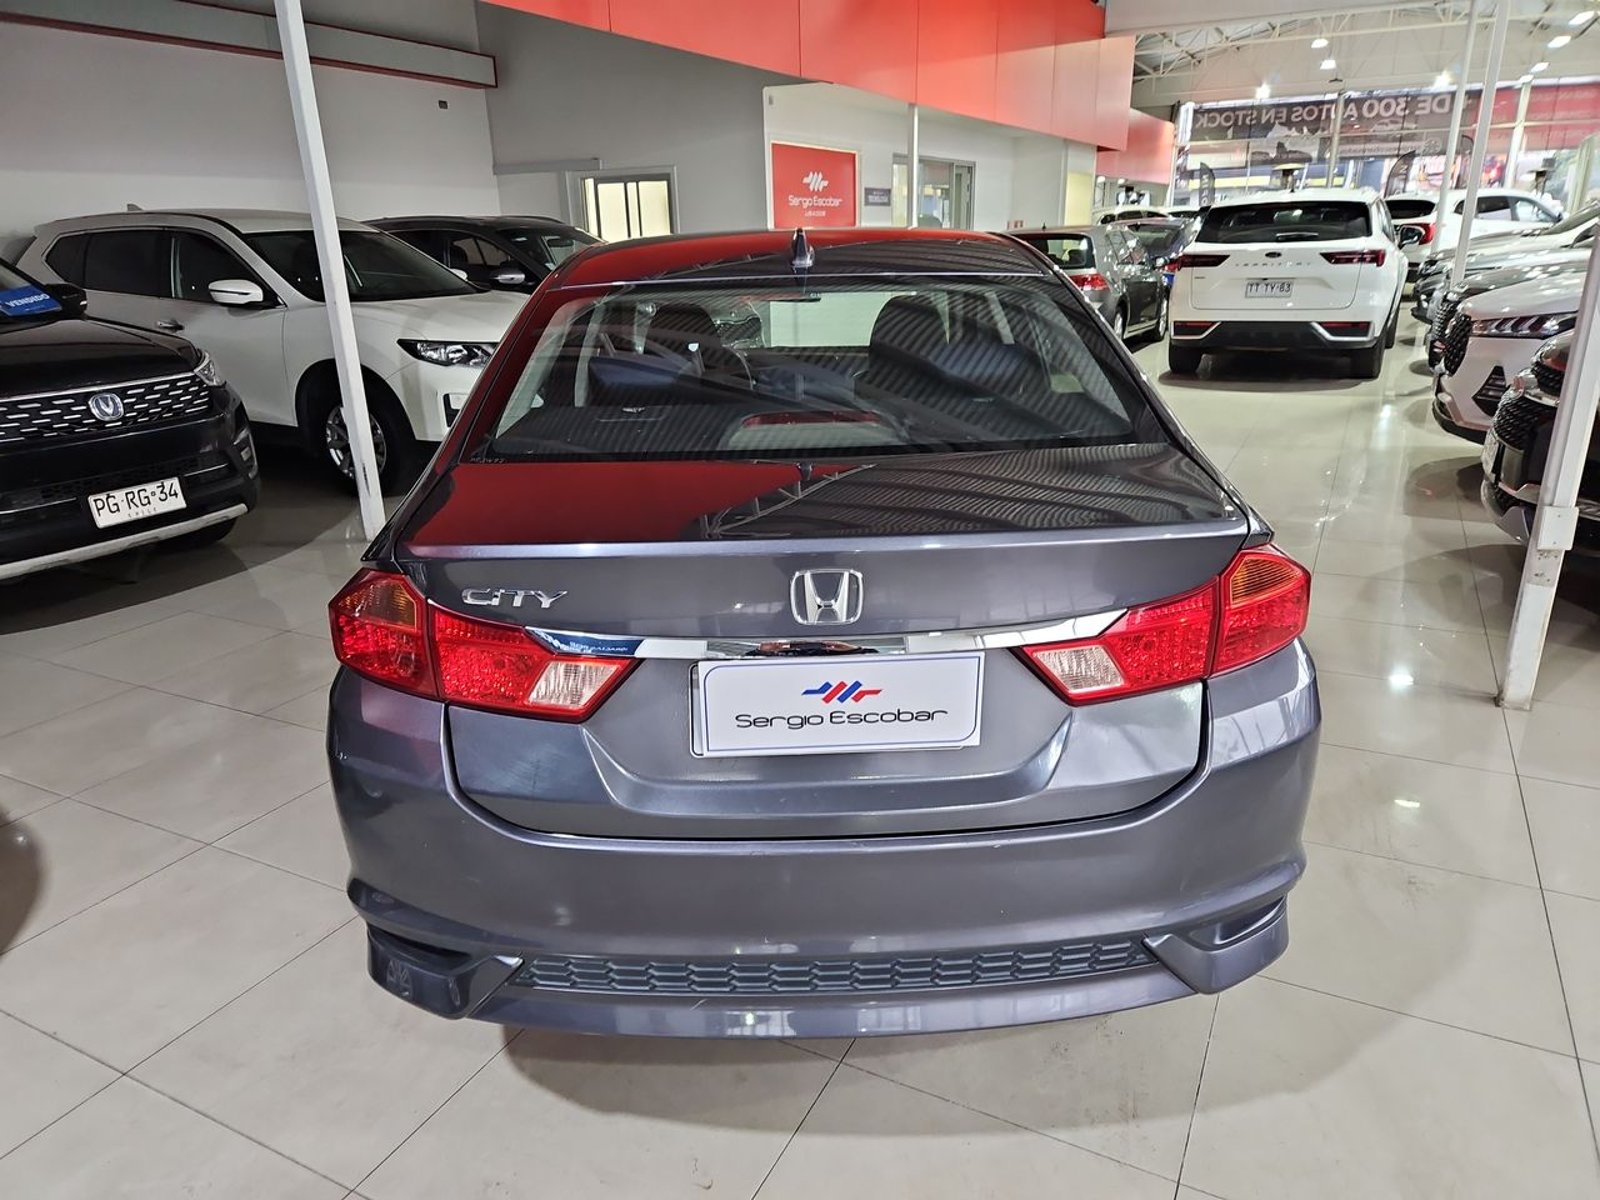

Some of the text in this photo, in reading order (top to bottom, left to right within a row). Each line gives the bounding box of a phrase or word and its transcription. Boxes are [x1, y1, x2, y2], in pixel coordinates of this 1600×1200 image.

[5, 293, 50, 307] VENDIDO
[461, 588, 568, 609] CITY
[735, 708, 949, 730] Sergio Escobar
